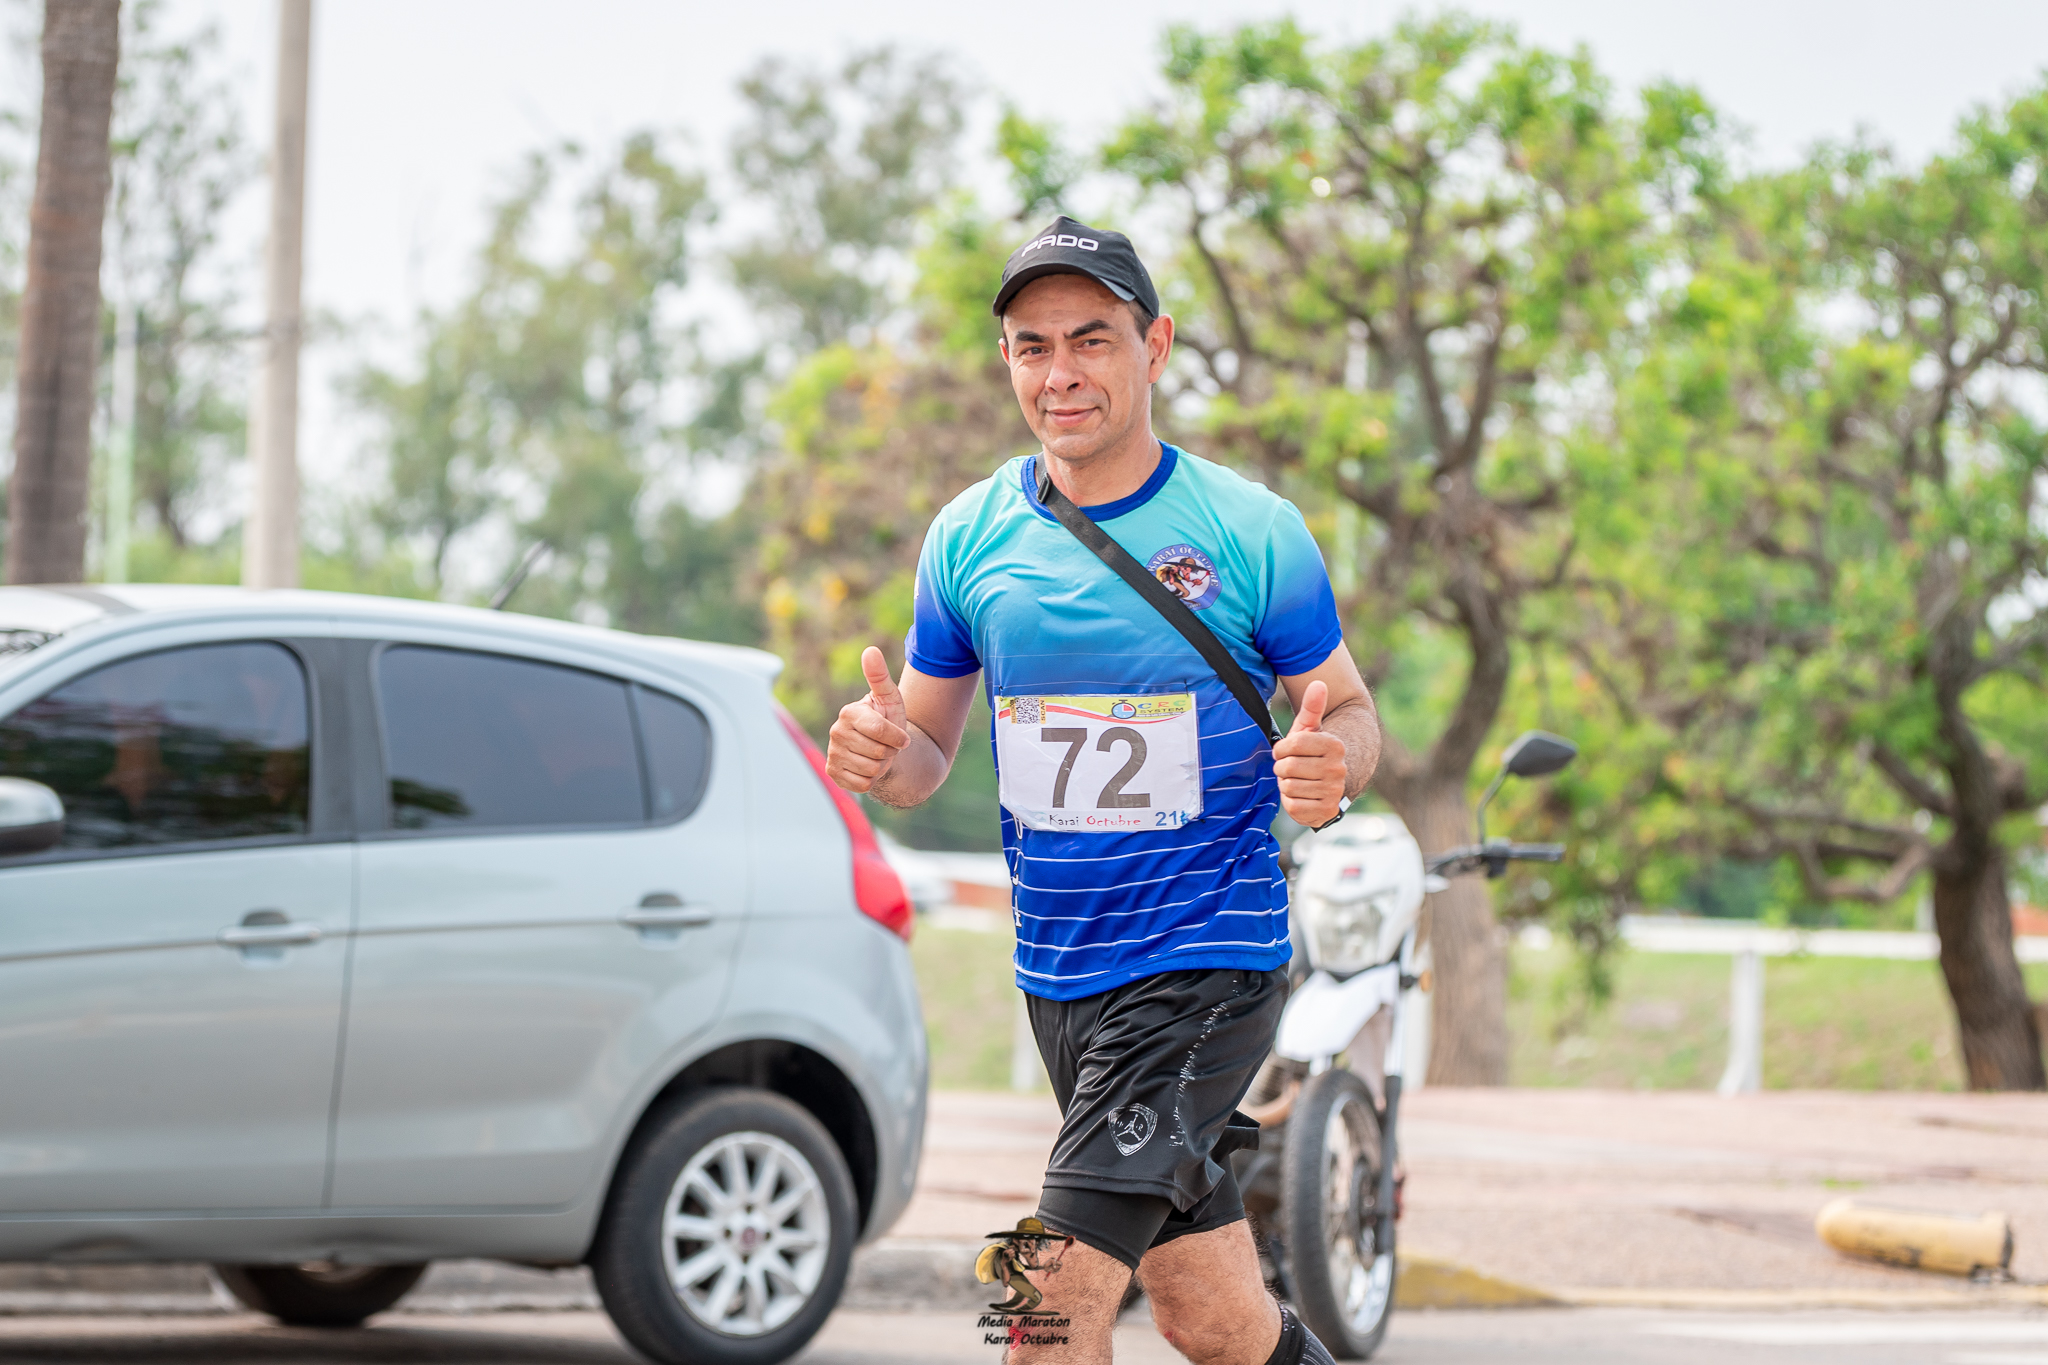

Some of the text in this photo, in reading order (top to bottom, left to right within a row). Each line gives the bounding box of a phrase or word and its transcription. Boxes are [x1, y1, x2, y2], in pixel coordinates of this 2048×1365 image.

[1021, 234, 1099, 258] PADO
[1041, 727, 1151, 808] 72
[1049, 815, 1079, 826] Karai
[1086, 815, 1141, 827] Octubre
